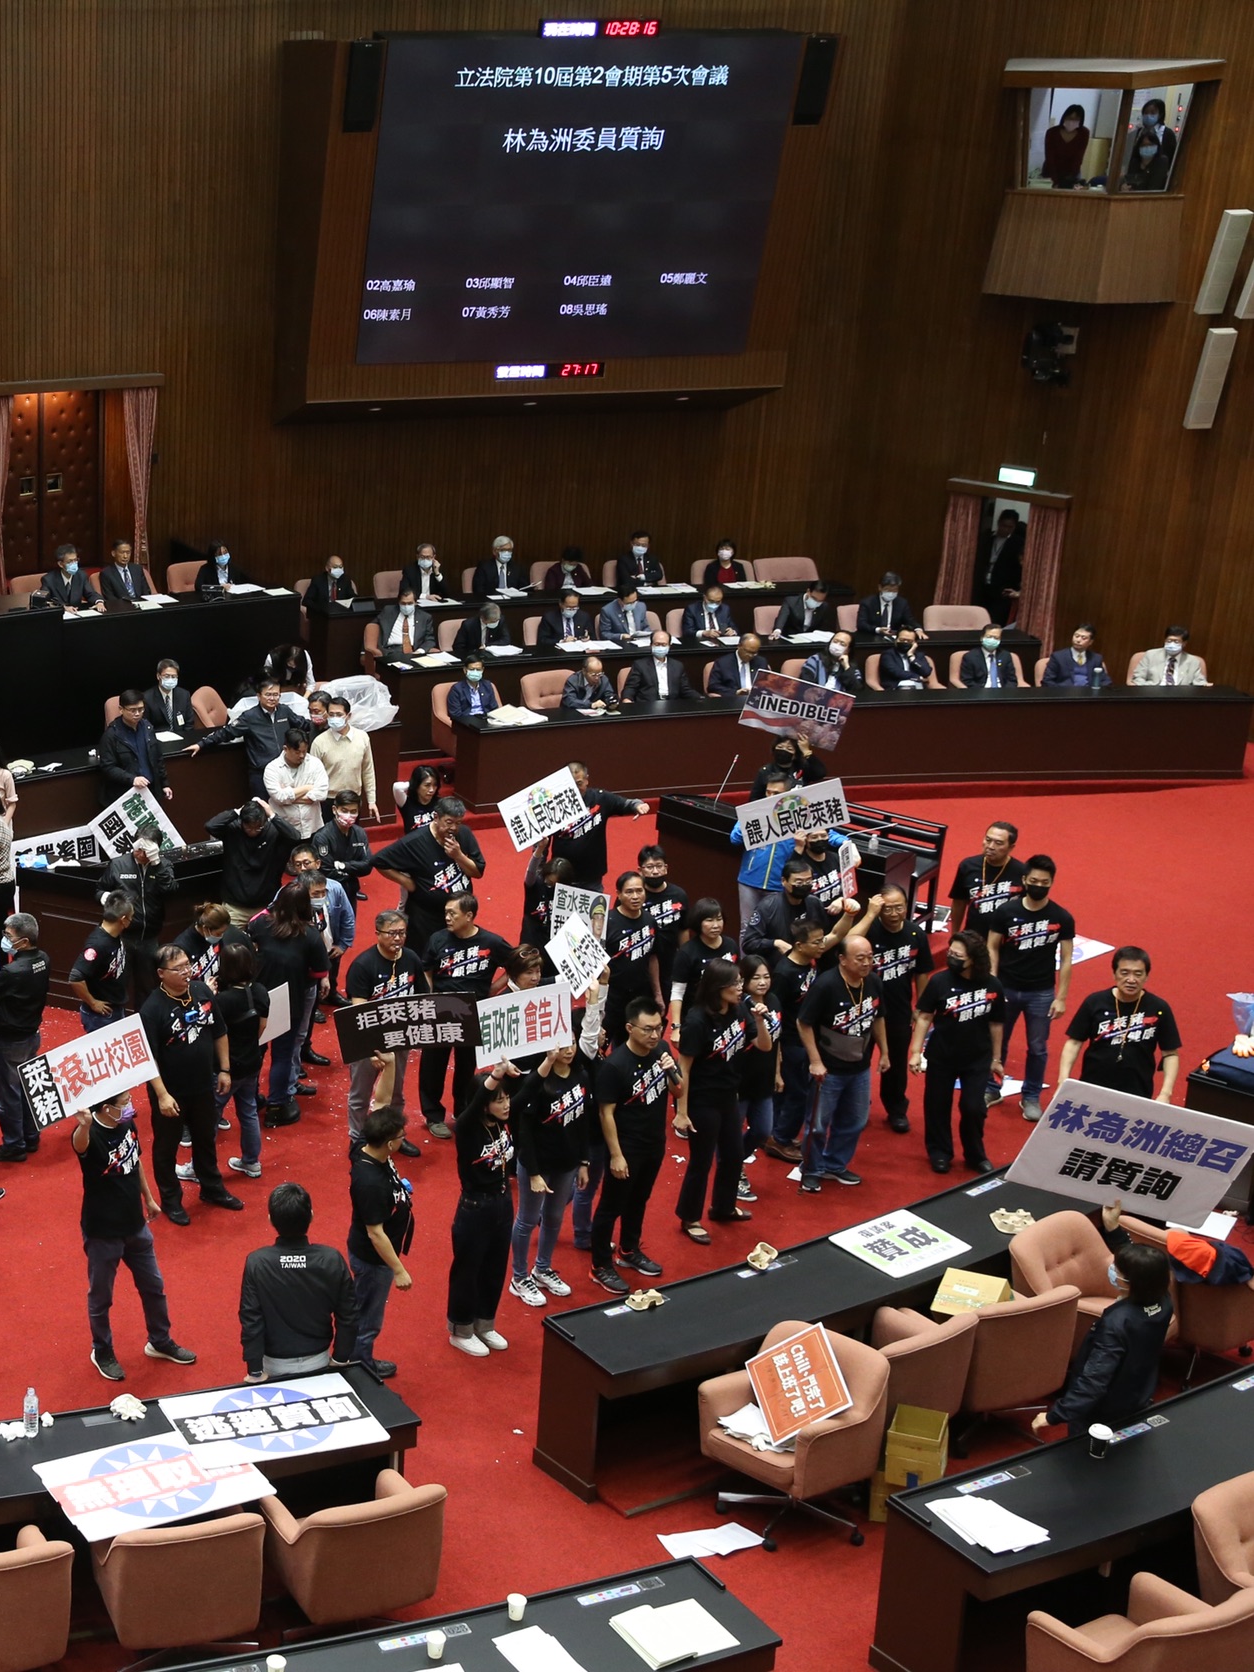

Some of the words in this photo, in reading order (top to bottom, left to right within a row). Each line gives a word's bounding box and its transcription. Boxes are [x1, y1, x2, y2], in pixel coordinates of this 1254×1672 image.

[605, 21, 658, 36] 10:28:16
[455, 65, 729, 88] 立法院第10屆第2會期第5次會議
[502, 126, 665, 152] 林為洲委員質詢
[366, 278, 416, 292] 02高嘉瑜
[465, 276, 515, 290] 03邱顯智
[363, 308, 412, 322] 06陳素月
[462, 306, 511, 320] 07黃秀芳
[559, 303, 608, 317] 08吳思瑤
[561, 362, 598, 377] 27:17
[759, 694, 840, 725] INEDIBLE
[509, 786, 585, 846] 餵人民吃萊豬
[744, 796, 846, 845] 餵人民吃萊豬
[556, 887, 591, 916] 查水表
[438, 944, 481, 969] 反萊豬
[452, 957, 491, 978] 顧健康
[945, 988, 988, 1008] 反萊豬
[356, 998, 438, 1031] 拒萊豬
[480, 1003, 521, 1055] 有政府
[523, 992, 568, 1044] 會告人
[1096, 1011, 1146, 1035] 反萊豬
[382, 1020, 465, 1050] 要健康
[49, 1028, 150, 1104] 滾出校園
[22, 1058, 64, 1126] 萊豬
[1048, 1099, 1250, 1174] 林為洲總召
[1057, 1147, 1183, 1202] 請質詢
[862, 1226, 940, 1262] 贊成
[279, 1255, 307, 1263] 2020
[184, 1396, 364, 1443] 逃避質詢
